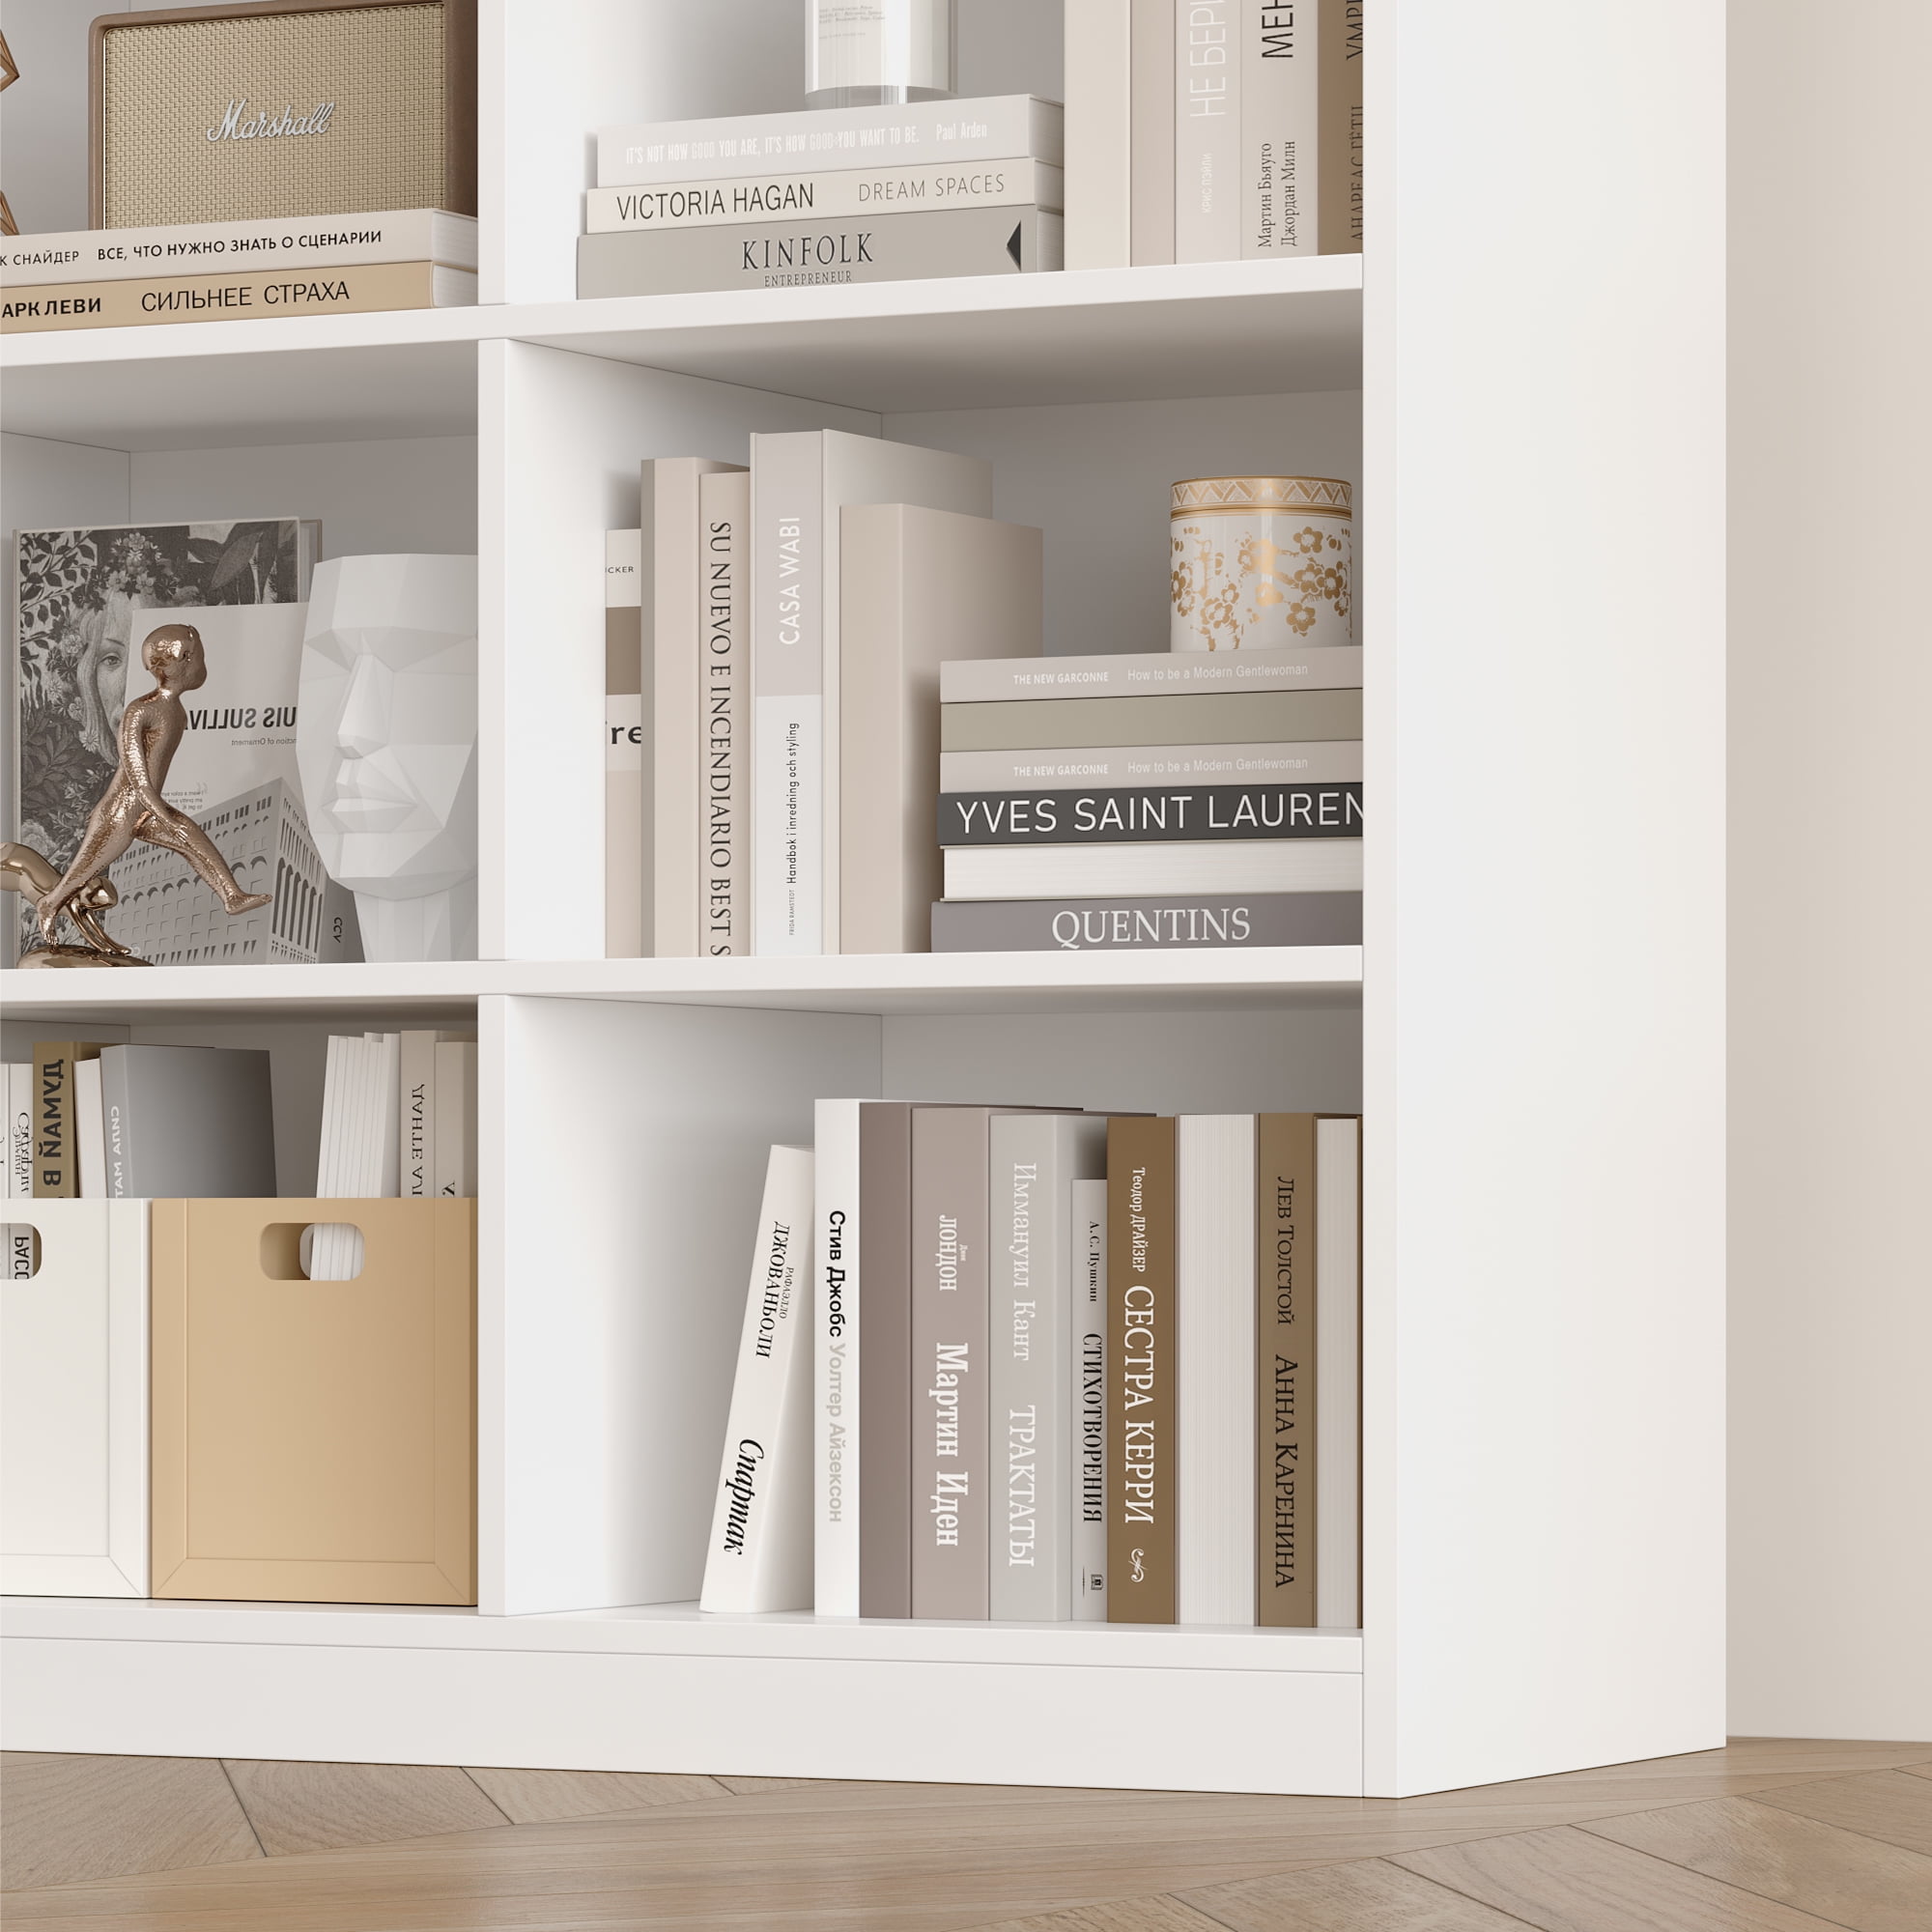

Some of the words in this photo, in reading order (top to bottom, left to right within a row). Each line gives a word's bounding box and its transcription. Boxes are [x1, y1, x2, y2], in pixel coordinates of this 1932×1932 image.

[1190, 76, 1226, 117] НЕ
[207, 99, 335, 142] Marshall
[936, 124, 956, 141] Paul
[961, 121, 987, 139] Arden
[626, 147, 642, 164] IT'S
[646, 145, 665, 162] NOT
[668, 143, 688, 161] HOW
[692, 142, 715, 159] GOOD
[720, 139, 737, 157] YOU
[740, 137, 760, 156] ARE,
[765, 136, 781, 154] IT'S
[785, 134, 807, 153] HOW
[838, 130, 856, 148] YOU
[860, 128, 886, 147] WANT
[890, 128, 900, 145] TO
[905, 126, 920, 143] BE.
[1258, 143, 1275, 189] Бьяуго
[1281, 141, 1295, 181] Милн
[617, 189, 725, 221] VICTORIA
[733, 183, 814, 213] HAGAN
[859, 179, 925, 202] DREAM
[935, 174, 1006, 197] SPACES
[1202, 187, 1212, 213] КРИС
[1258, 191, 1275, 247] Мартин
[1281, 185, 1299, 246] Джордан
[14, 250, 79, 266] СНАЙДЕР
[98, 247, 128, 261] ВСЕ,
[133, 244, 162, 257] ЧТО
[167, 241, 225, 256] НУЖНО
[231, 237, 276, 252] ЗНАТЬ
[281, 236, 294, 248] О
[298, 230, 382, 249] СЦЕНАРИИ
[742, 233, 873, 270] KINFOLK
[141, 287, 252, 312] СИЛЬНЕЕ
[264, 281, 350, 304] СТРАХА
[764, 270, 853, 287] ENTREPRENEUR
[2, 301, 40, 318] АРК
[44, 298, 101, 315] ЛЕВИ
[710, 522, 731, 553] SU
[779, 517, 800, 578] WABI
[710, 562, 731, 655] NUEVO
[779, 584, 800, 645] CASA
[710, 665, 731, 676] E
[1013, 674, 1032, 685] THE
[1034, 673, 1055, 685] NEW
[1057, 671, 1109, 683] GARCONNE
[1127, 669, 1151, 681] How
[1153, 669, 1165, 680] to
[1167, 668, 1180, 680] be
[1183, 670, 1190, 679] a
[1193, 666, 1233, 679] Modern
[1236, 664, 1309, 677] Gentlewoman
[786, 723, 800, 756] styling
[710, 686, 731, 867] INCENDIARIO
[786, 759, 797, 778] och
[1013, 766, 1032, 778] THE
[1034, 765, 1055, 777] NEW
[1057, 764, 1109, 776] GARCONNE
[1127, 761, 1151, 774] How
[1153, 761, 1165, 773] to
[1167, 760, 1180, 773] be
[1183, 762, 1190, 772] a
[1193, 758, 1233, 772] Modern
[1236, 757, 1309, 771] Gentlewoman
[786, 781, 800, 830] inredning
[956, 799, 1057, 834] YVES
[1074, 795, 1193, 833] SAINT
[1208, 791, 1363, 829] LAUREN
[786, 838, 797, 884] Handbok
[710, 878, 731, 936] BEST
[1052, 907, 1251, 951] QUENTINS
[1129, 1167, 1146, 1212] Теодор
[829, 1210, 846, 1261] Стив
[1009, 1162, 1037, 1288] Иммануил
[1130, 1213, 1149, 1272] ДРАЙЗЕР
[935, 1214, 957, 1292] ЛОНДОН
[755, 1221, 790, 1358] ДЖОВАНЬОЛИ
[1088, 1252, 1100, 1302] Пушкин
[826, 1266, 846, 1338] Джобс
[1014, 1299, 1037, 1361] Кант
[1124, 1285, 1154, 1410] СЕСТРА
[826, 1343, 846, 1417] Уолтер
[928, 1342, 969, 1458] Мартин
[1083, 1333, 1102, 1523] СТИХОТВОРЕНИЯ
[829, 1423, 846, 1522] Айзексон
[1009, 1405, 1036, 1567] ТРАКТАТЫ
[1125, 1420, 1154, 1523] КЕРРИ
[724, 1438, 764, 1555] Спартак
[930, 1471, 969, 1547] Иден
